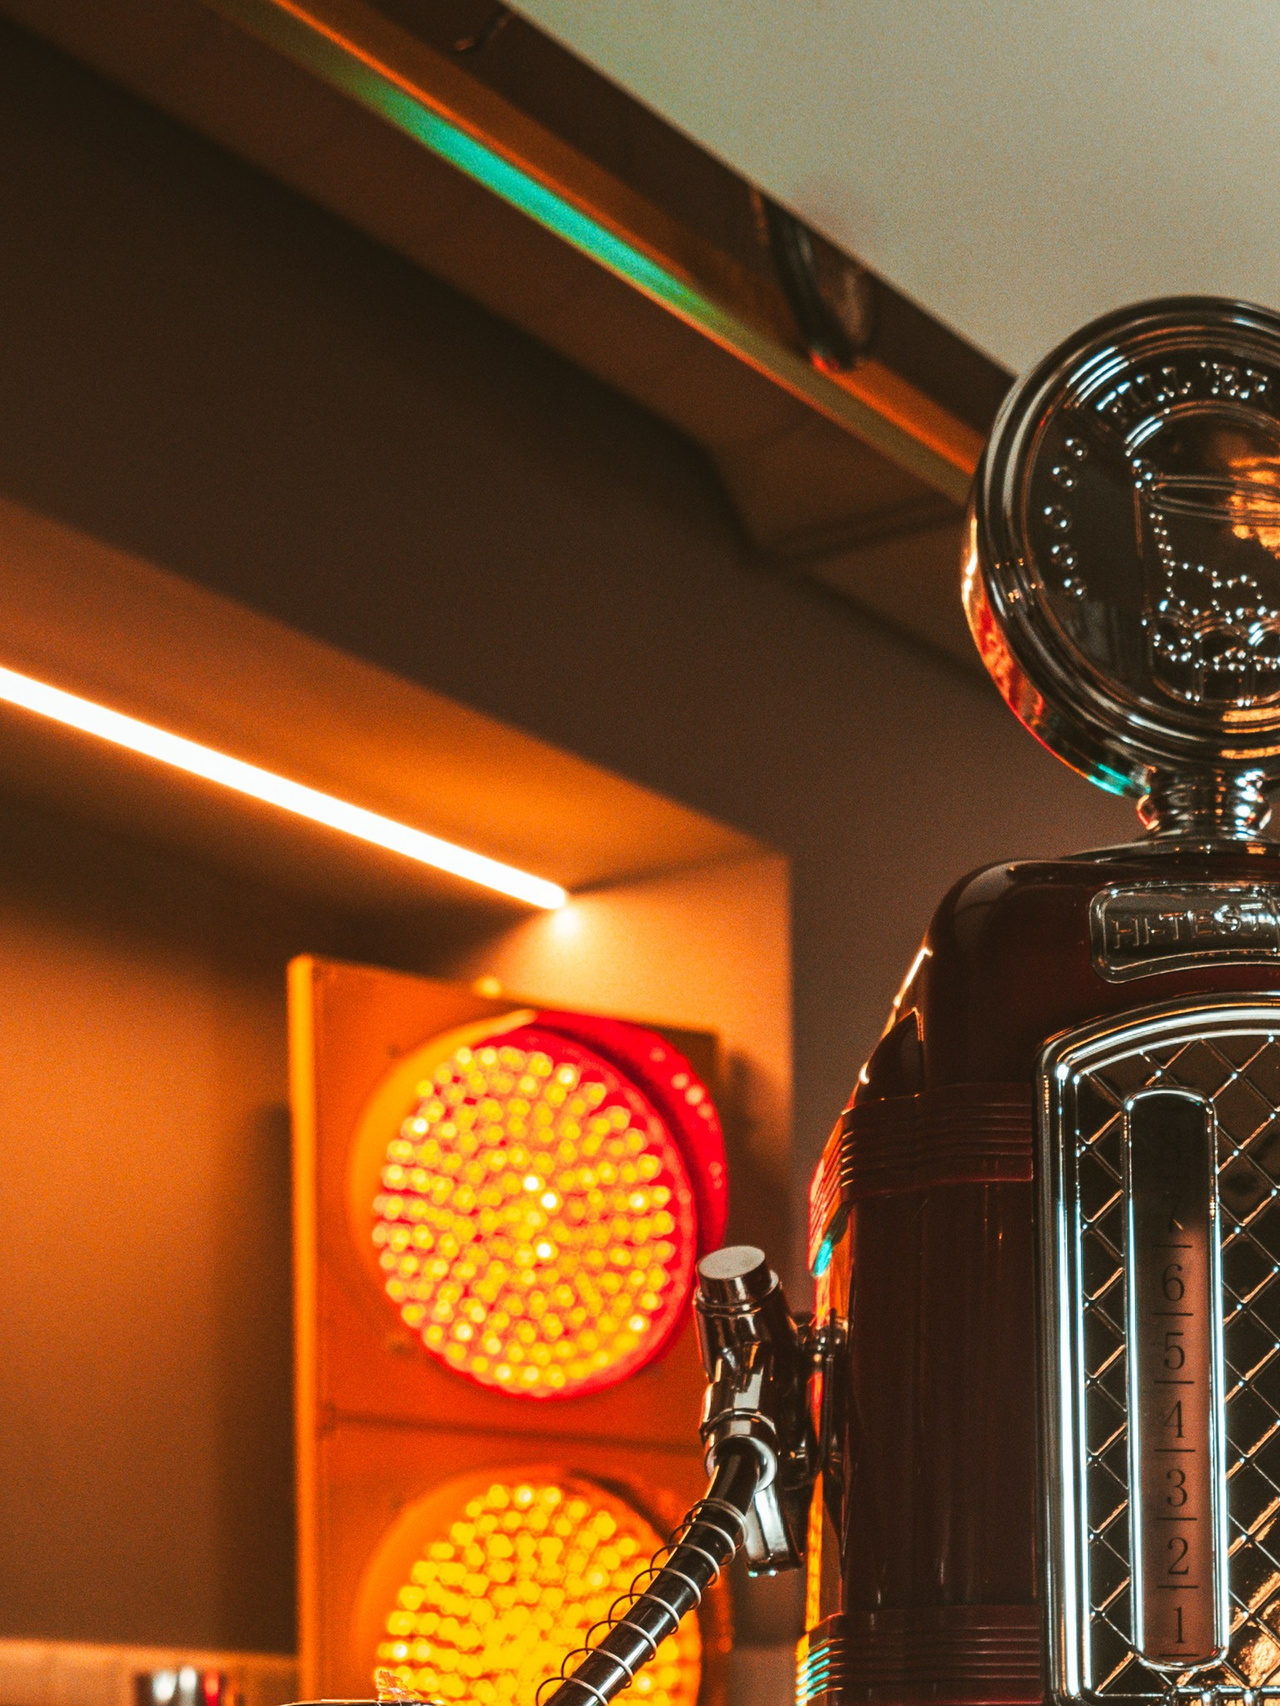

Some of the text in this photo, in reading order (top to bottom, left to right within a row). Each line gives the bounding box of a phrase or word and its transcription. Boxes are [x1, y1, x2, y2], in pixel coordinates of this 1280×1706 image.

[1163, 1265, 1186, 1300] 6
[1163, 1332, 1186, 1370] 5
[1163, 1402, 1185, 1439] 4
[1166, 1468, 1188, 1508] 3
[1167, 1538, 1190, 1576] 2
[1174, 1607, 1185, 1644] 1
